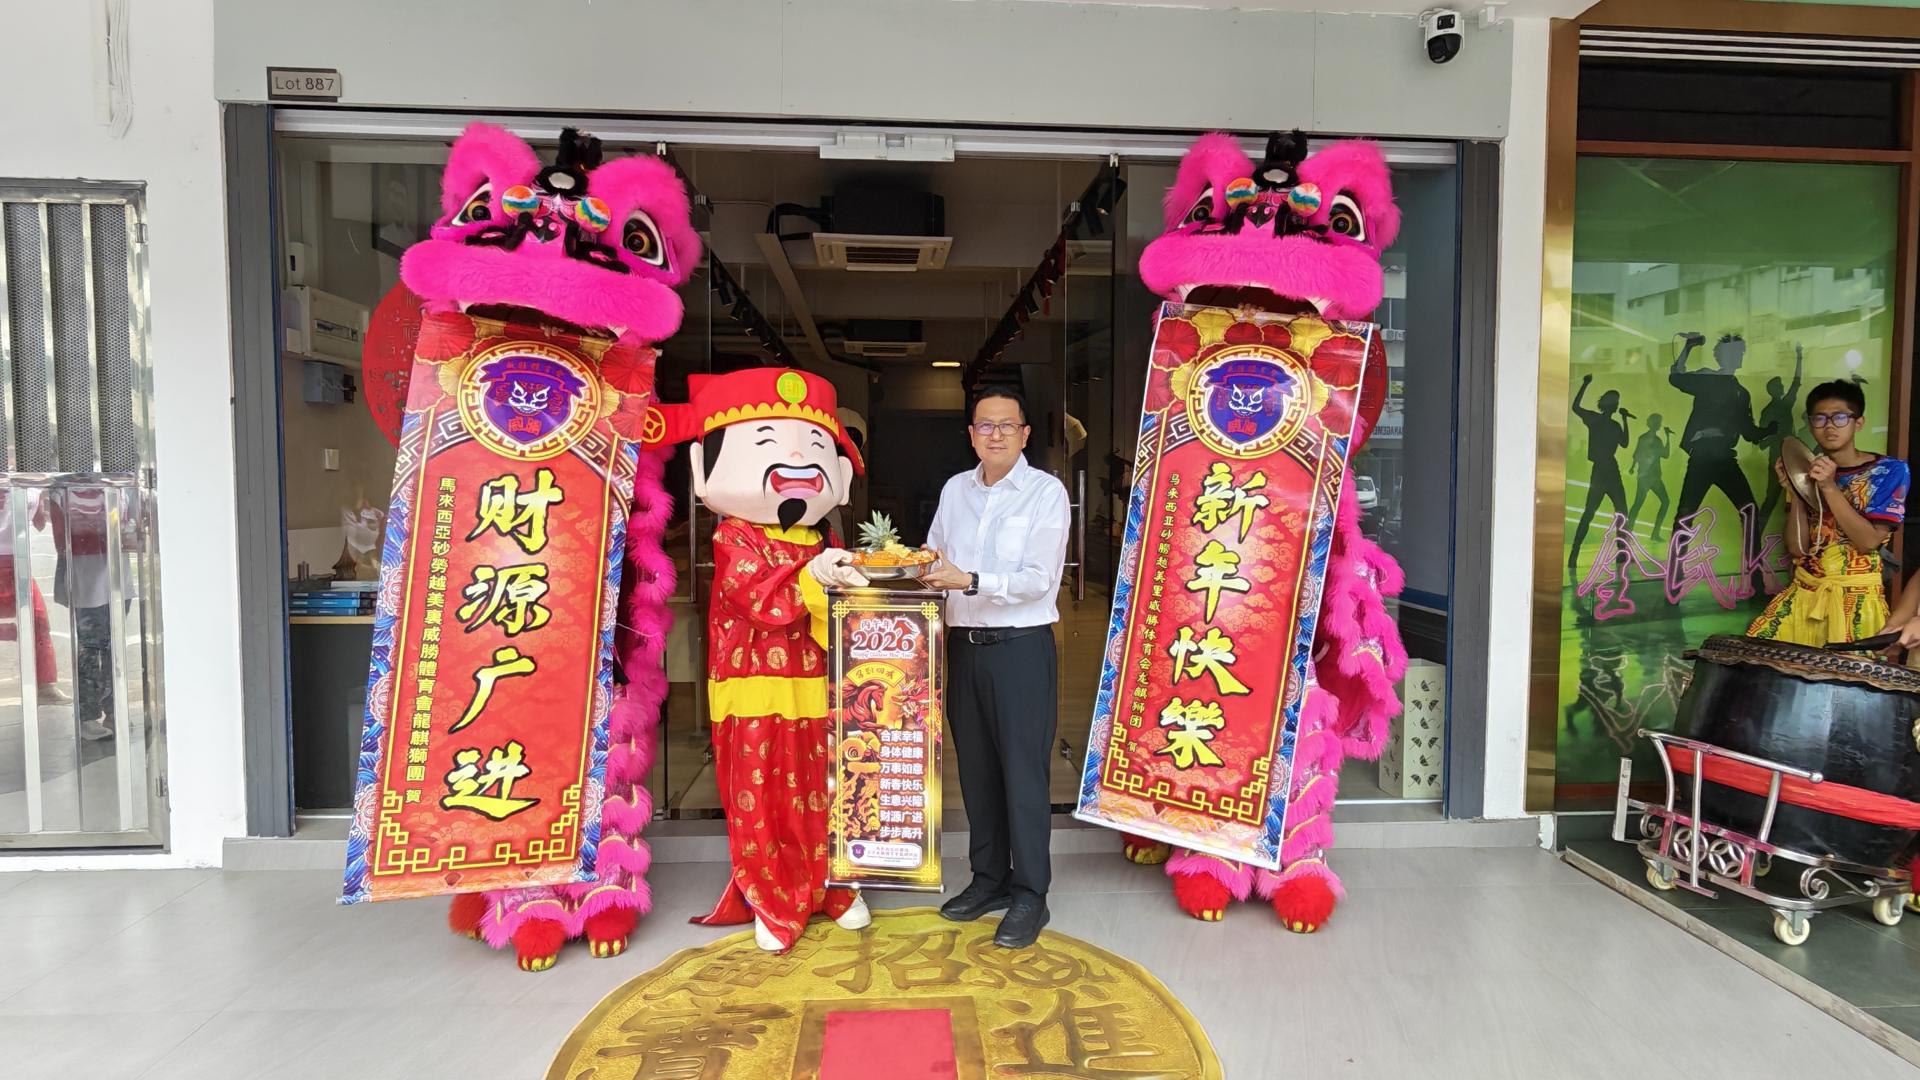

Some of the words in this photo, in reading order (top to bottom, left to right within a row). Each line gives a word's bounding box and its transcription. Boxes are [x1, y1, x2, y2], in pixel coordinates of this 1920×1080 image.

[275, 76, 301, 90] Lot
[305, 77, 334, 91] 887
[1155, 461, 1270, 769] 新年快樂
[439, 468, 565, 821] 财源广进
[853, 630, 915, 652] 2026
[880, 730, 924, 742] 合家幸福
[880, 746, 924, 759] 身体健康
[880, 762, 924, 775] 万事如意
[880, 778, 924, 791] 新春快乐
[880, 794, 924, 807] 生意兴隆
[880, 810, 924, 823] 财源广进
[880, 827, 924, 839] 步步高升
[811, 926, 972, 994] 招
